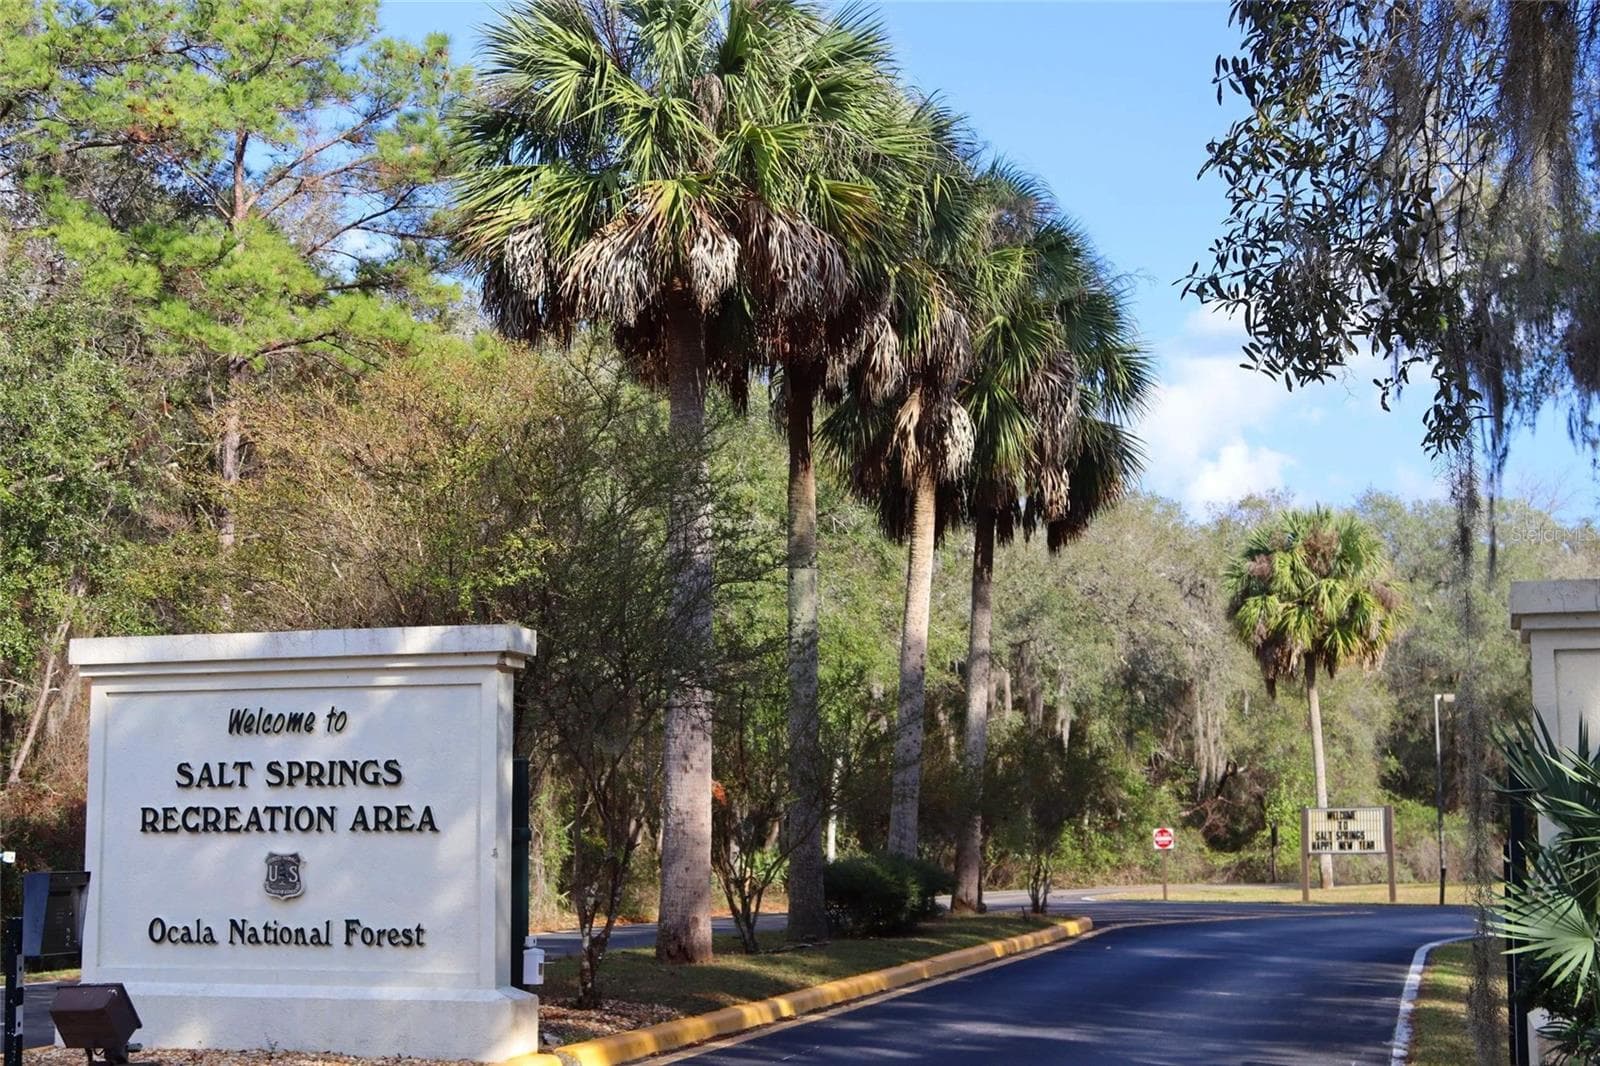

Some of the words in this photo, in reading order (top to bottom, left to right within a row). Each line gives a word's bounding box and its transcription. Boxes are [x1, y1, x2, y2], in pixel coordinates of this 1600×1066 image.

[228, 706, 315, 735] Welcome
[326, 706, 347, 733] to
[176, 761, 254, 788] SALT
[266, 759, 403, 787] SPRINGS
[140, 806, 337, 834] RECREATION
[349, 804, 440, 833] AREA
[1311, 841, 1333, 850] HAPPY
[1339, 841, 1353, 850] NEW
[1359, 840, 1375, 850] YEAR
[1315, 831, 1332, 840] SALT
[1336, 830, 1365, 840] SPRINGS
[148, 917, 219, 946] Ocala
[228, 918, 333, 947] National
[343, 919, 425, 948] Forest
